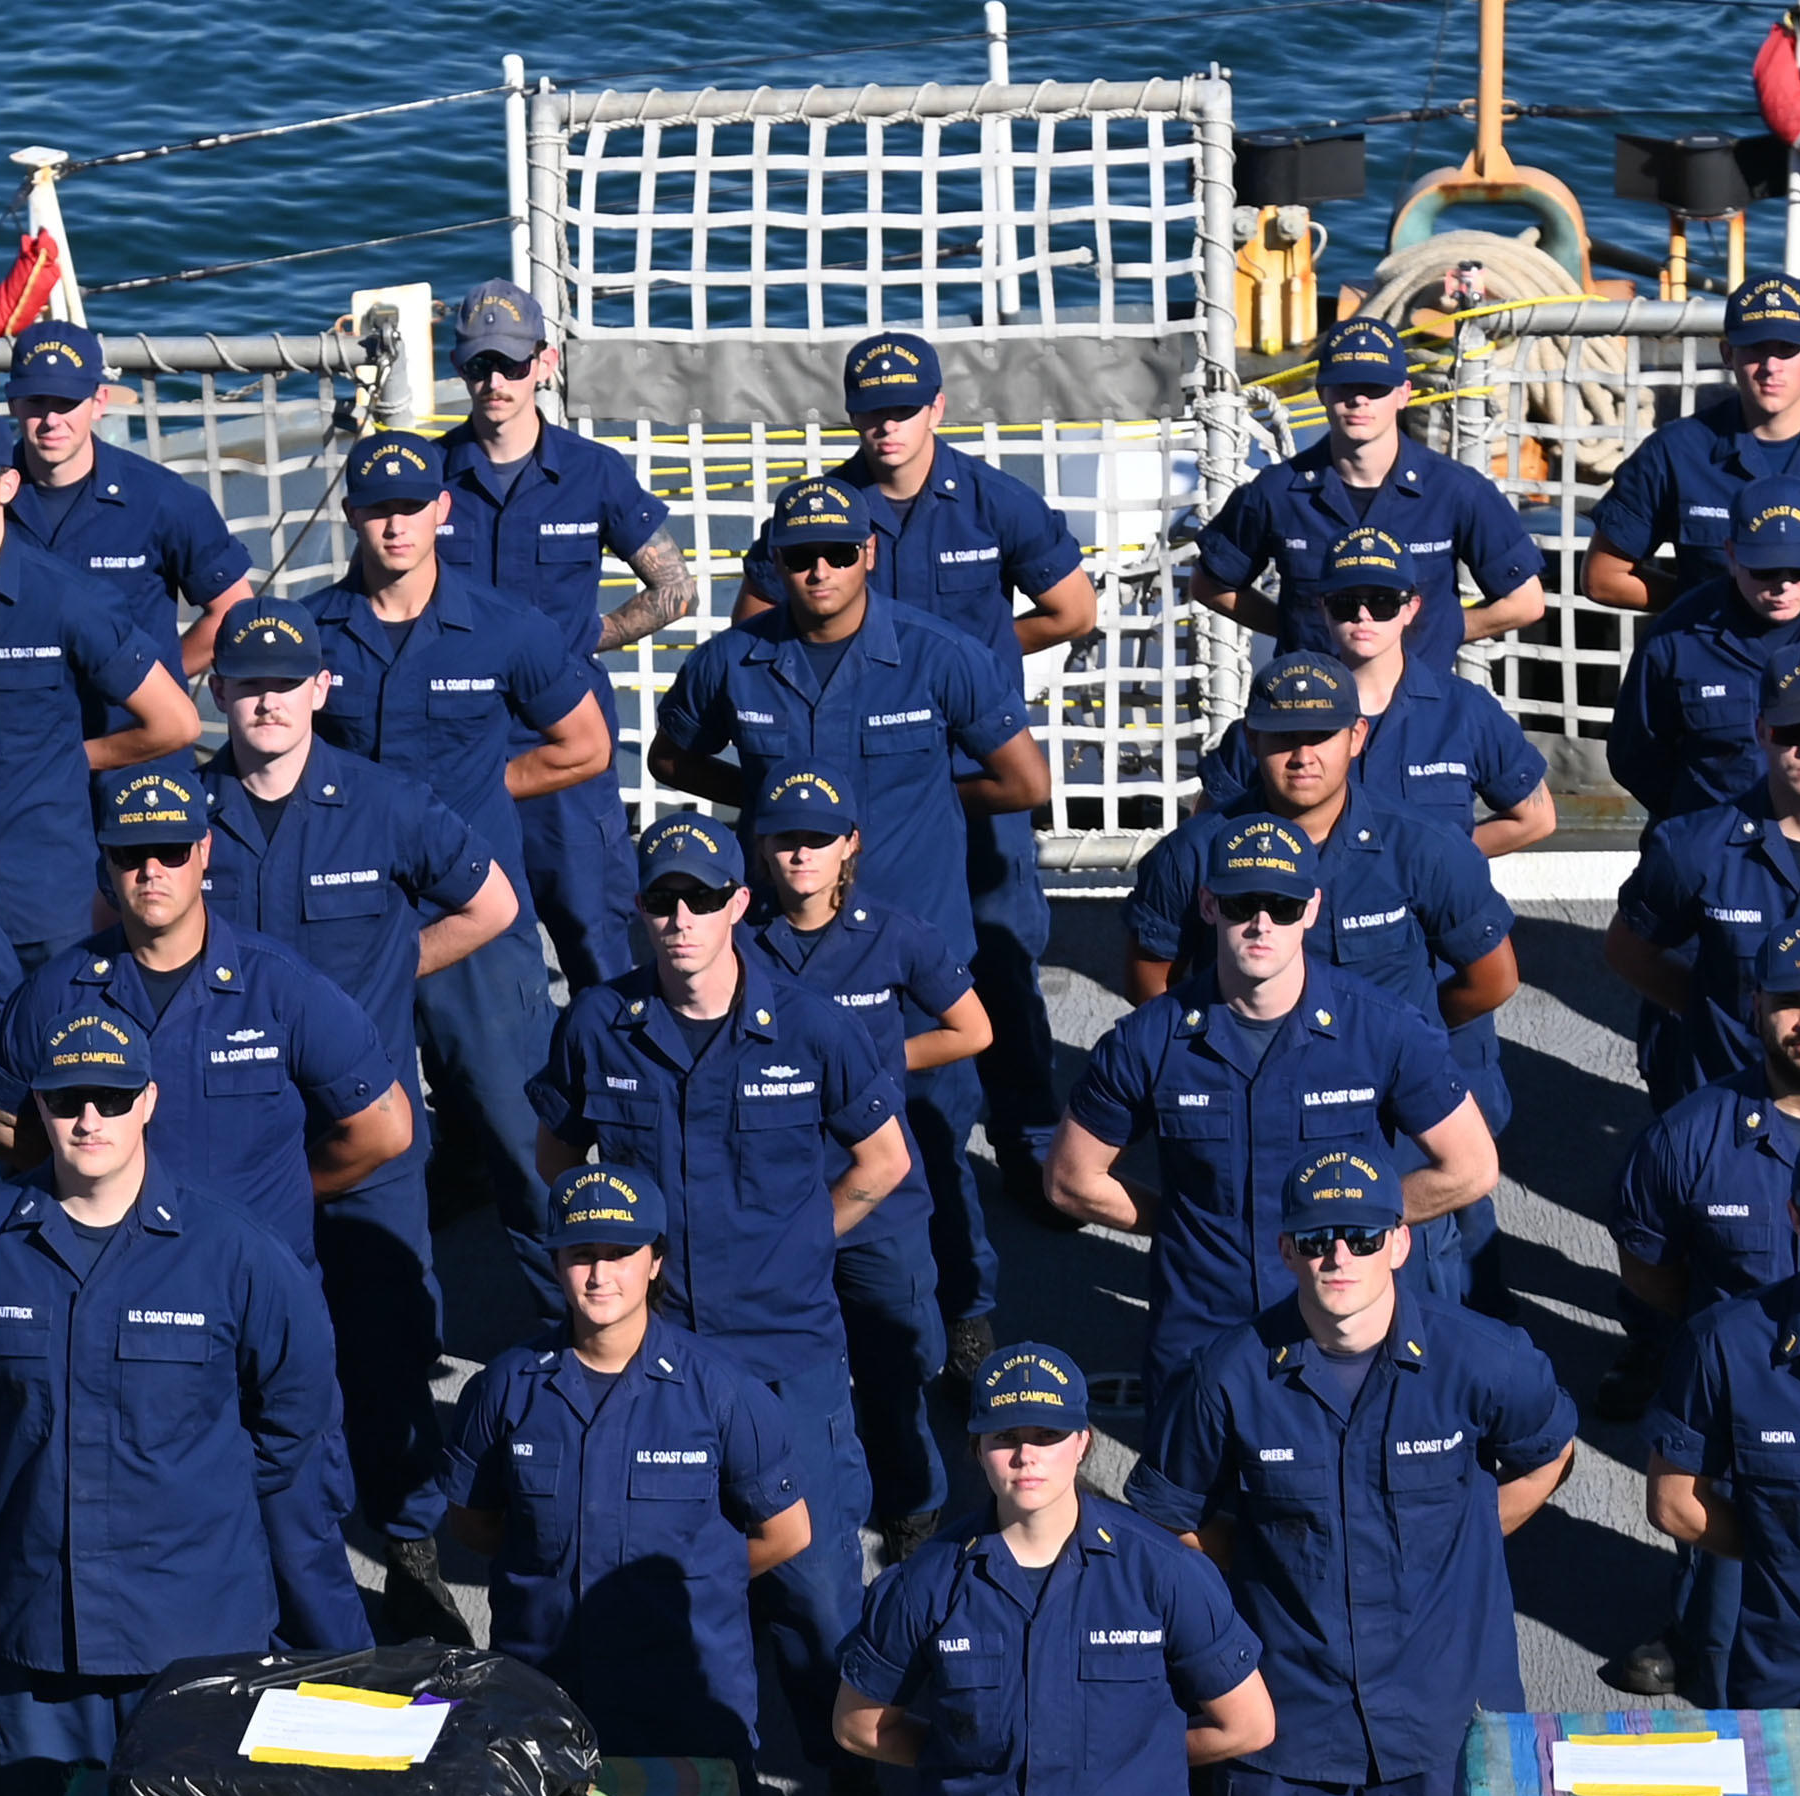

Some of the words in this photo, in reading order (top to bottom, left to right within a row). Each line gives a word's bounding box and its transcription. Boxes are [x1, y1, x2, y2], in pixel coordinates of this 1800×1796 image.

[1701, 684, 1727, 698] STARK
[310, 874, 325, 887] U.S.
[324, 871, 351, 886] COAST
[350, 869, 379, 883] GUARD
[50, 1030, 68, 1047] U.S.
[67, 1015, 99, 1033] COAST
[100, 1020, 129, 1046] GUARD
[52, 1052, 80, 1066] USCGC
[81, 1051, 126, 1065] CAMPBELL
[210, 1050, 228, 1064] U.S.
[227, 1047, 254, 1063] COAST
[254, 1046, 279, 1060] GUARD
[743, 1083, 761, 1097] U.S.
[759, 1083, 789, 1097] COAST
[788, 1081, 816, 1095] GUARD
[1303, 1092, 1321, 1106] U.S.
[1319, 1089, 1349, 1105] COAST
[1347, 1087, 1376, 1103] GUARD
[1299, 1167, 1316, 1184] U.S.
[1316, 1151, 1348, 1169] COAST
[1349, 1155, 1378, 1182] GUARD
[128, 1309, 144, 1323] U.S.
[143, 1310, 174, 1325] COAST
[173, 1311, 205, 1327] GUARD
[985, 1369, 1004, 1387] U.S.
[1003, 1354, 1037, 1371] COAST
[1038, 1358, 1069, 1385] GUARD
[990, 1391, 1018, 1408] USCGC
[1019, 1390, 1065, 1407] CAMPBELL
[1760, 1430, 1796, 1444] KUCHTA
[512, 1443, 534, 1457] VIRZI
[1259, 1448, 1295, 1462] GREENE
[1396, 1440, 1413, 1456] U.S.
[1413, 1439, 1443, 1455] COAST
[636, 1450, 652, 1464] U.S.
[652, 1450, 682, 1464] COAST
[681, 1450, 708, 1465] GUARD
[938, 1637, 971, 1653] FULLER
[1089, 1630, 1109, 1645] U.S.
[1108, 1629, 1139, 1645] COAST
